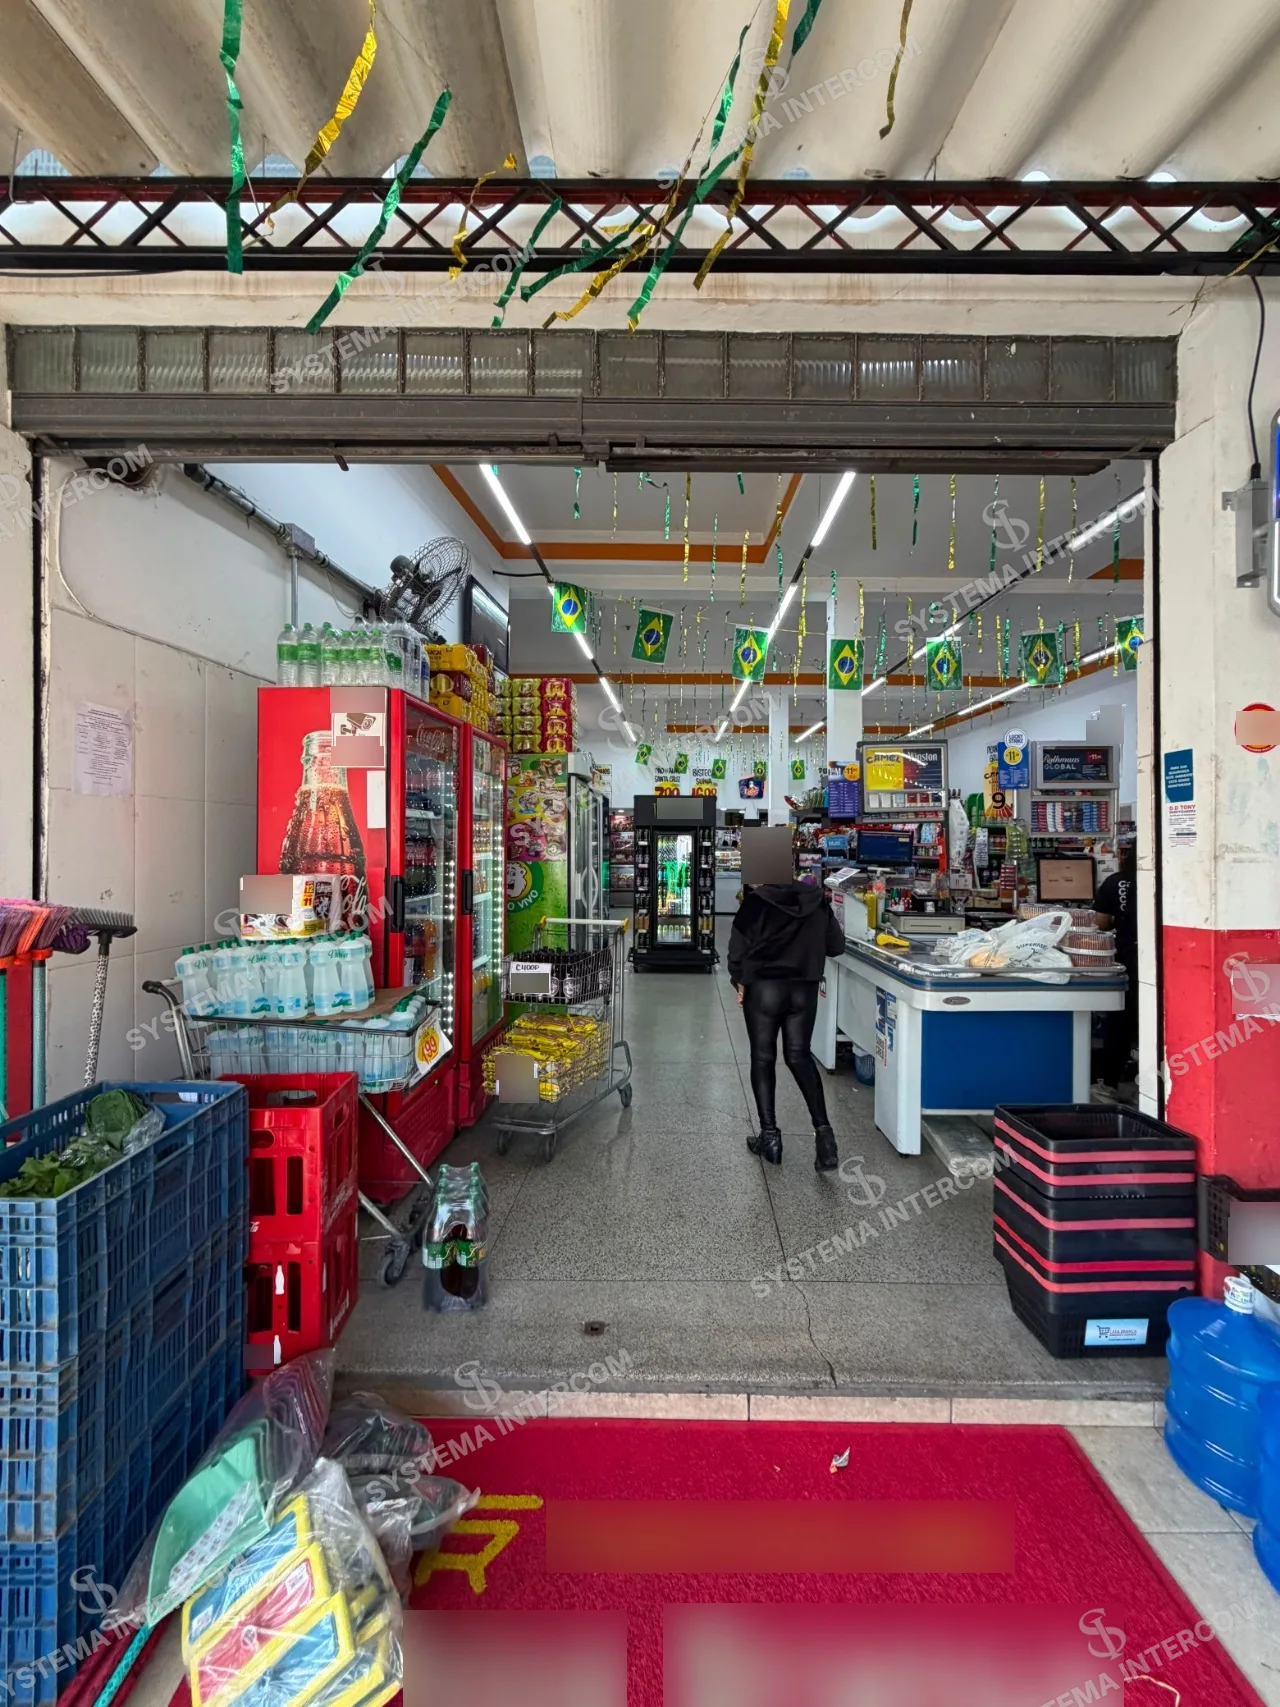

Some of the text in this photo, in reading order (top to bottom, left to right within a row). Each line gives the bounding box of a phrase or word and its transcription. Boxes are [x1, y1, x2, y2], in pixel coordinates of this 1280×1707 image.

[866, 754, 901, 764] CAMEL
[908, 751, 938, 762] Winston
[1043, 754, 1080, 764] Rothmans
[692, 768, 713, 777] BISTEC
[517, 889, 539, 909] VIVO
